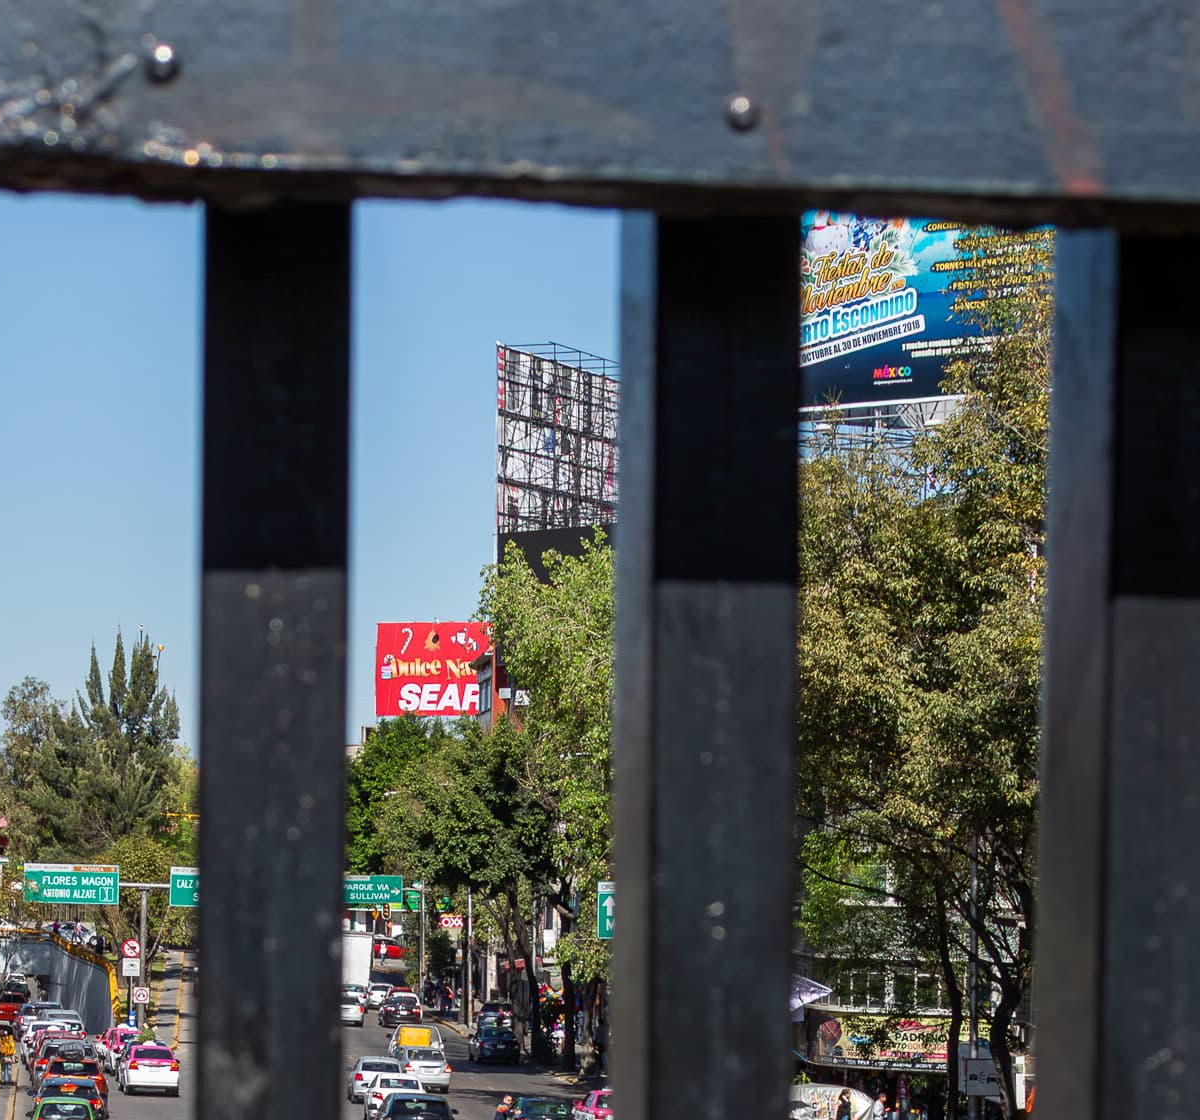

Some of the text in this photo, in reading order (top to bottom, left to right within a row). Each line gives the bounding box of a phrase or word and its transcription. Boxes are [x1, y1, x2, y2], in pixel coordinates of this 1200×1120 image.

[813, 242, 894, 288] Fiestas de
[833, 343, 842, 354] AL
[842, 340, 851, 351] 30
[852, 337, 862, 348] DE
[862, 326, 903, 346] NOVIEMBRE
[902, 319, 921, 333] 2018
[391, 657, 442, 679] Dulce
[42, 875, 114, 887] FLORES MAGON
[176, 879, 194, 889] CALZ
[376, 883, 390, 891] VIA
[72, 889, 97, 899] ALZATE
[349, 892, 390, 900] SULLIVAN
